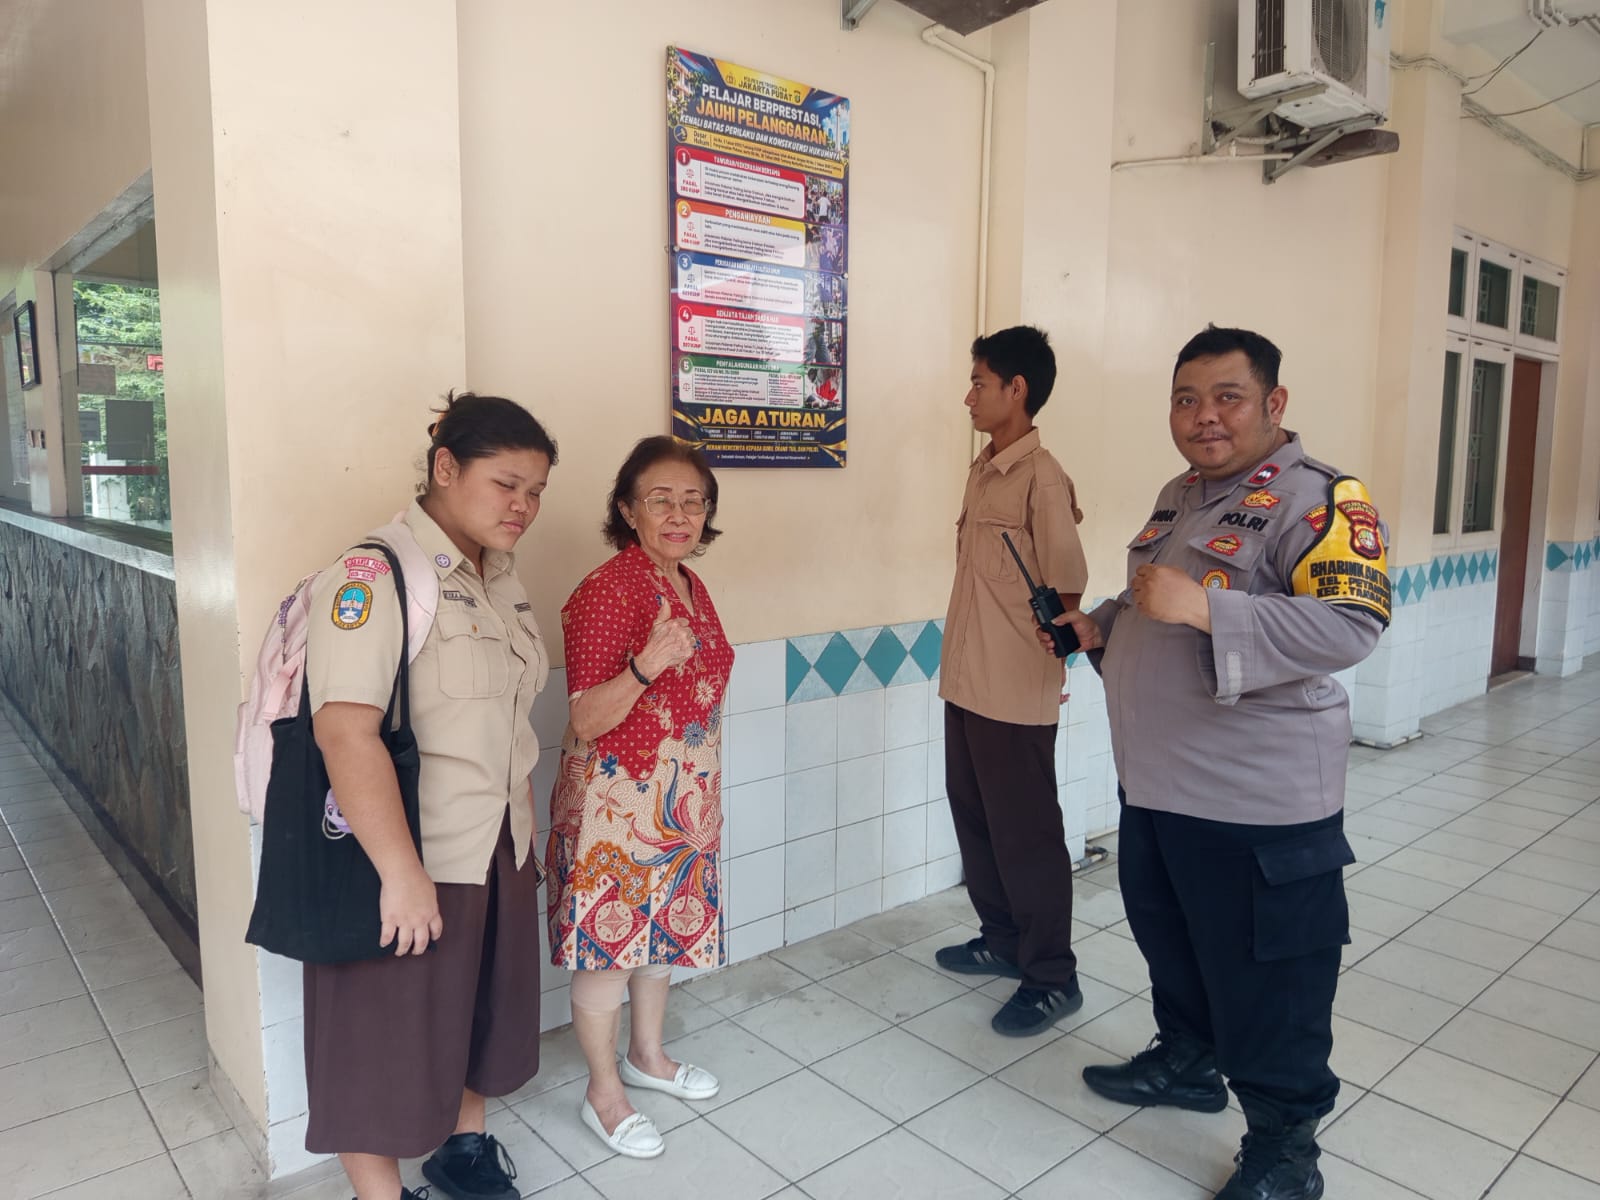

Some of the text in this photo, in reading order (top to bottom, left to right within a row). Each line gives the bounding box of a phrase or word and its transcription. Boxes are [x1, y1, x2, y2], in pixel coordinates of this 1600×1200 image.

[738, 79, 793, 101] JAKARTA PUSAT
[702, 83, 822, 128] PELAJAR BERPRESTASI,
[696, 98, 827, 146] JAUHI PELANGGARAN
[679, 115, 841, 162] KENALI BATAS PERILAKU DAN KONSEKUENSI HUKUMNYA
[693, 131, 707, 139] Dasar
[693, 137, 710, 147] Hukum
[681, 152, 687, 164] 1
[681, 206, 688, 216] 2
[725, 209, 771, 225] PENGANIAYAAN
[681, 257, 688, 267] 3
[682, 309, 689, 320] 4
[683, 361, 690, 370] 5
[699, 408, 827, 428] JAGA ATURAN
[1218, 512, 1270, 532] POLRI
